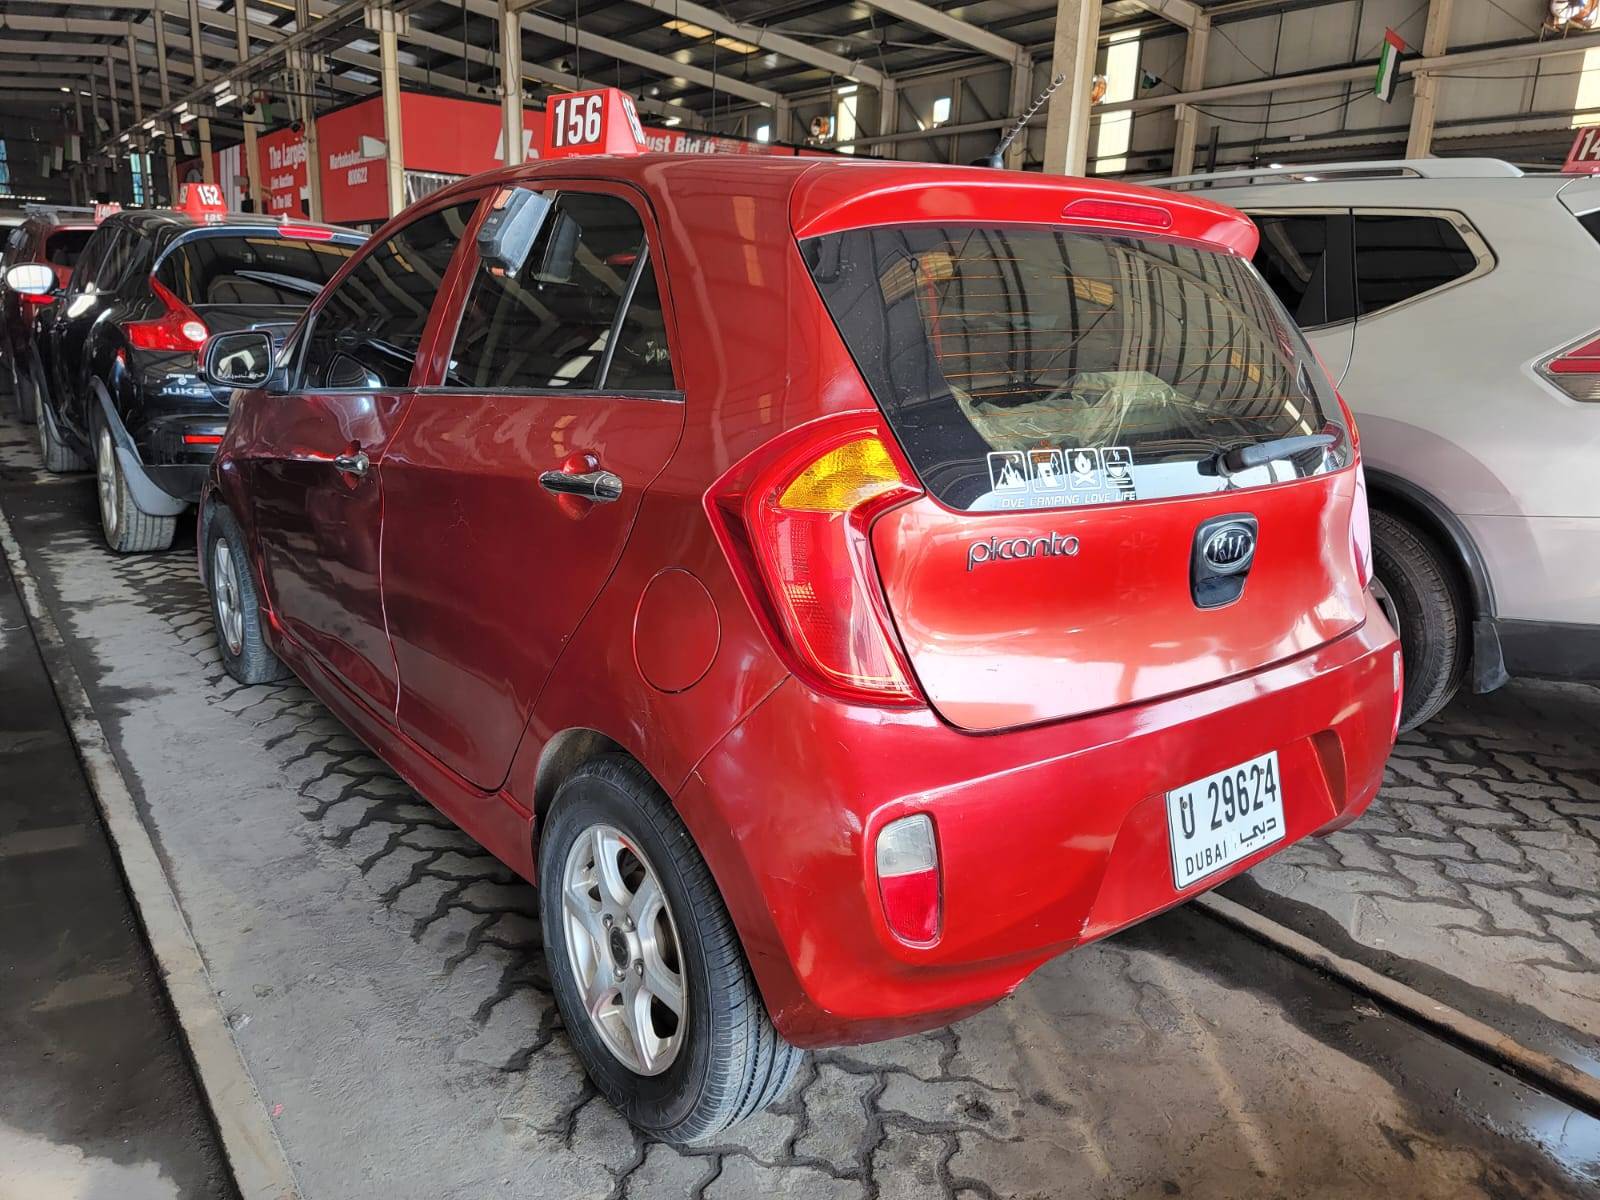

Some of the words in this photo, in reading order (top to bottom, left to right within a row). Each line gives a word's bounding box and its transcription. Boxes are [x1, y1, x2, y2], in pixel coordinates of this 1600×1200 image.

[555, 95, 603, 147] 156
[269, 145, 281, 170] The
[282, 142, 308, 170] Larges
[674, 135, 701, 153] Bid
[197, 185, 222, 205] 152
[998, 497, 1025, 508] OVE
[1085, 493, 1111, 504] LOVE
[967, 531, 1080, 572] picanto
[1179, 792, 1196, 840] U
[1207, 757, 1277, 831] 29624
[1239, 817, 1277, 848] دبي
[1185, 839, 1227, 876] DUBAI
